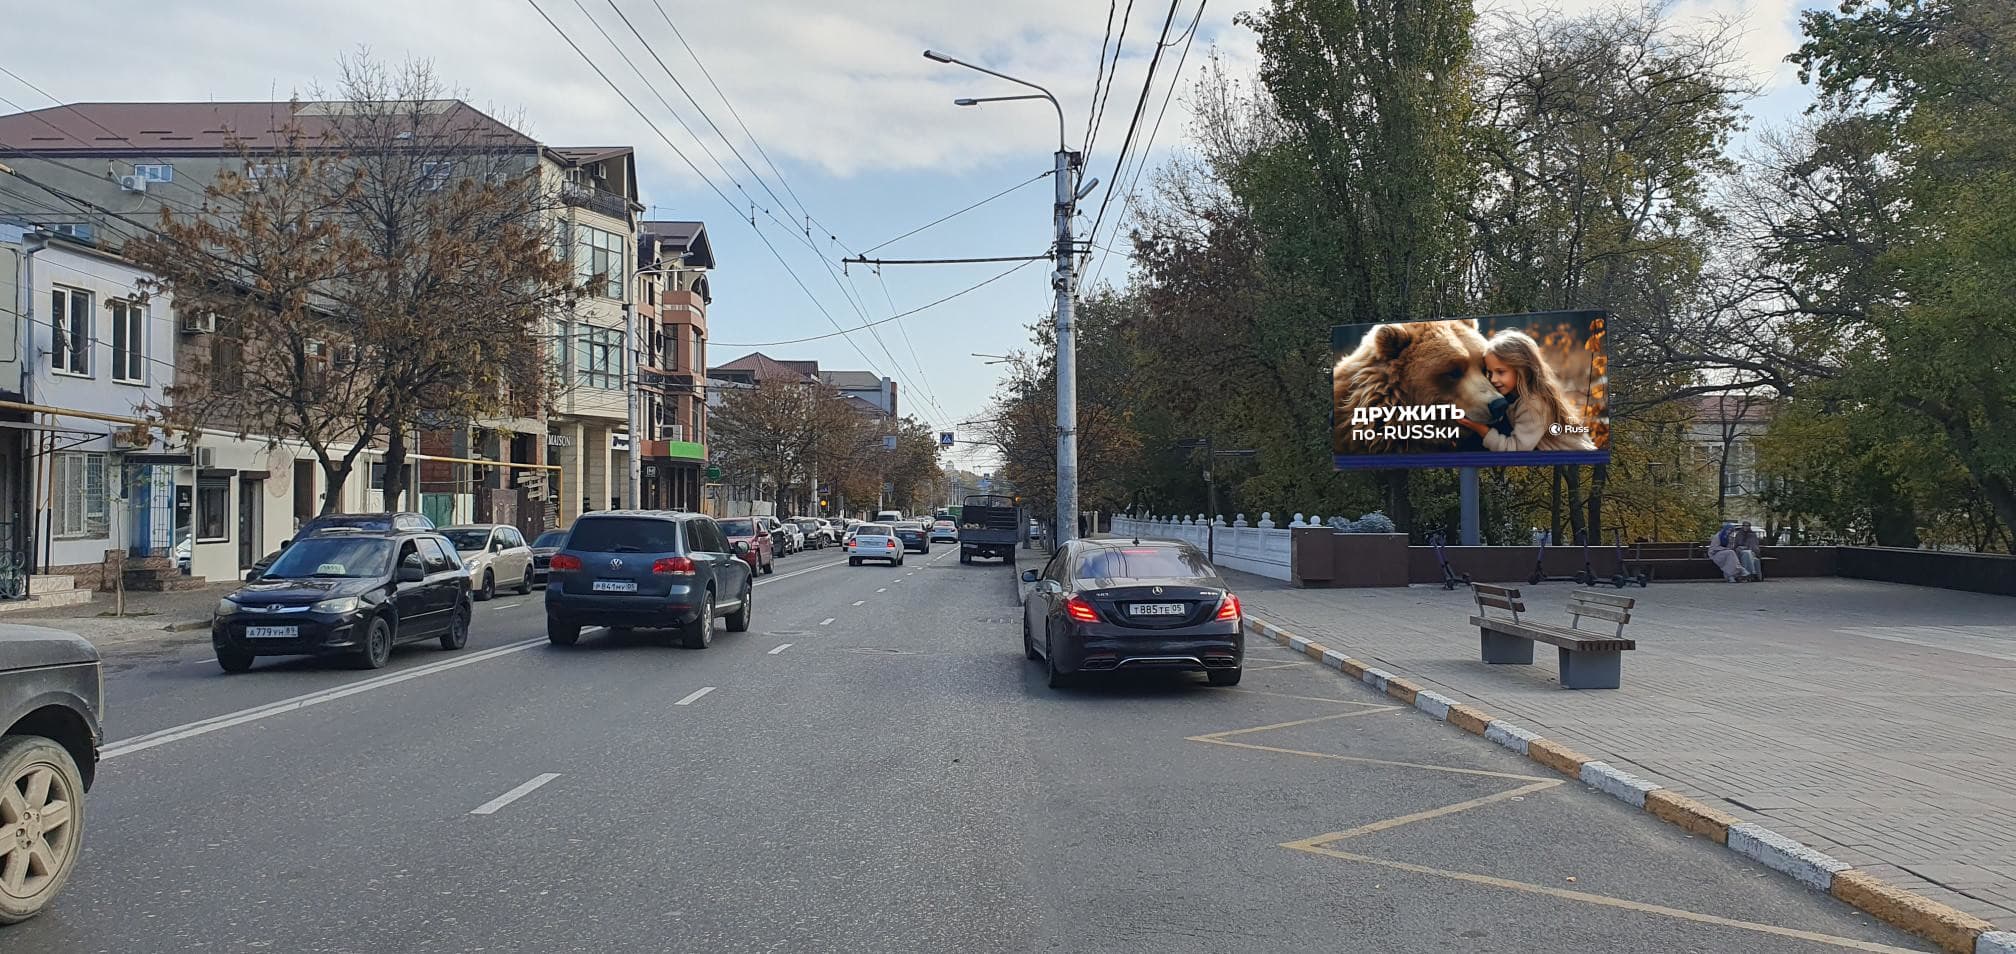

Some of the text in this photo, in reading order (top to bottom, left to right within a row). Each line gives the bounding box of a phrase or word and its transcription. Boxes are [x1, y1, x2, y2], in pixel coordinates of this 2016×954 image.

[1351, 404, 1465, 425] ДРУЖИТЬ
[1352, 424, 1460, 441] по-RUSSки
[1564, 424, 1590, 433] Russ
[548, 434, 571, 447] MAISON
